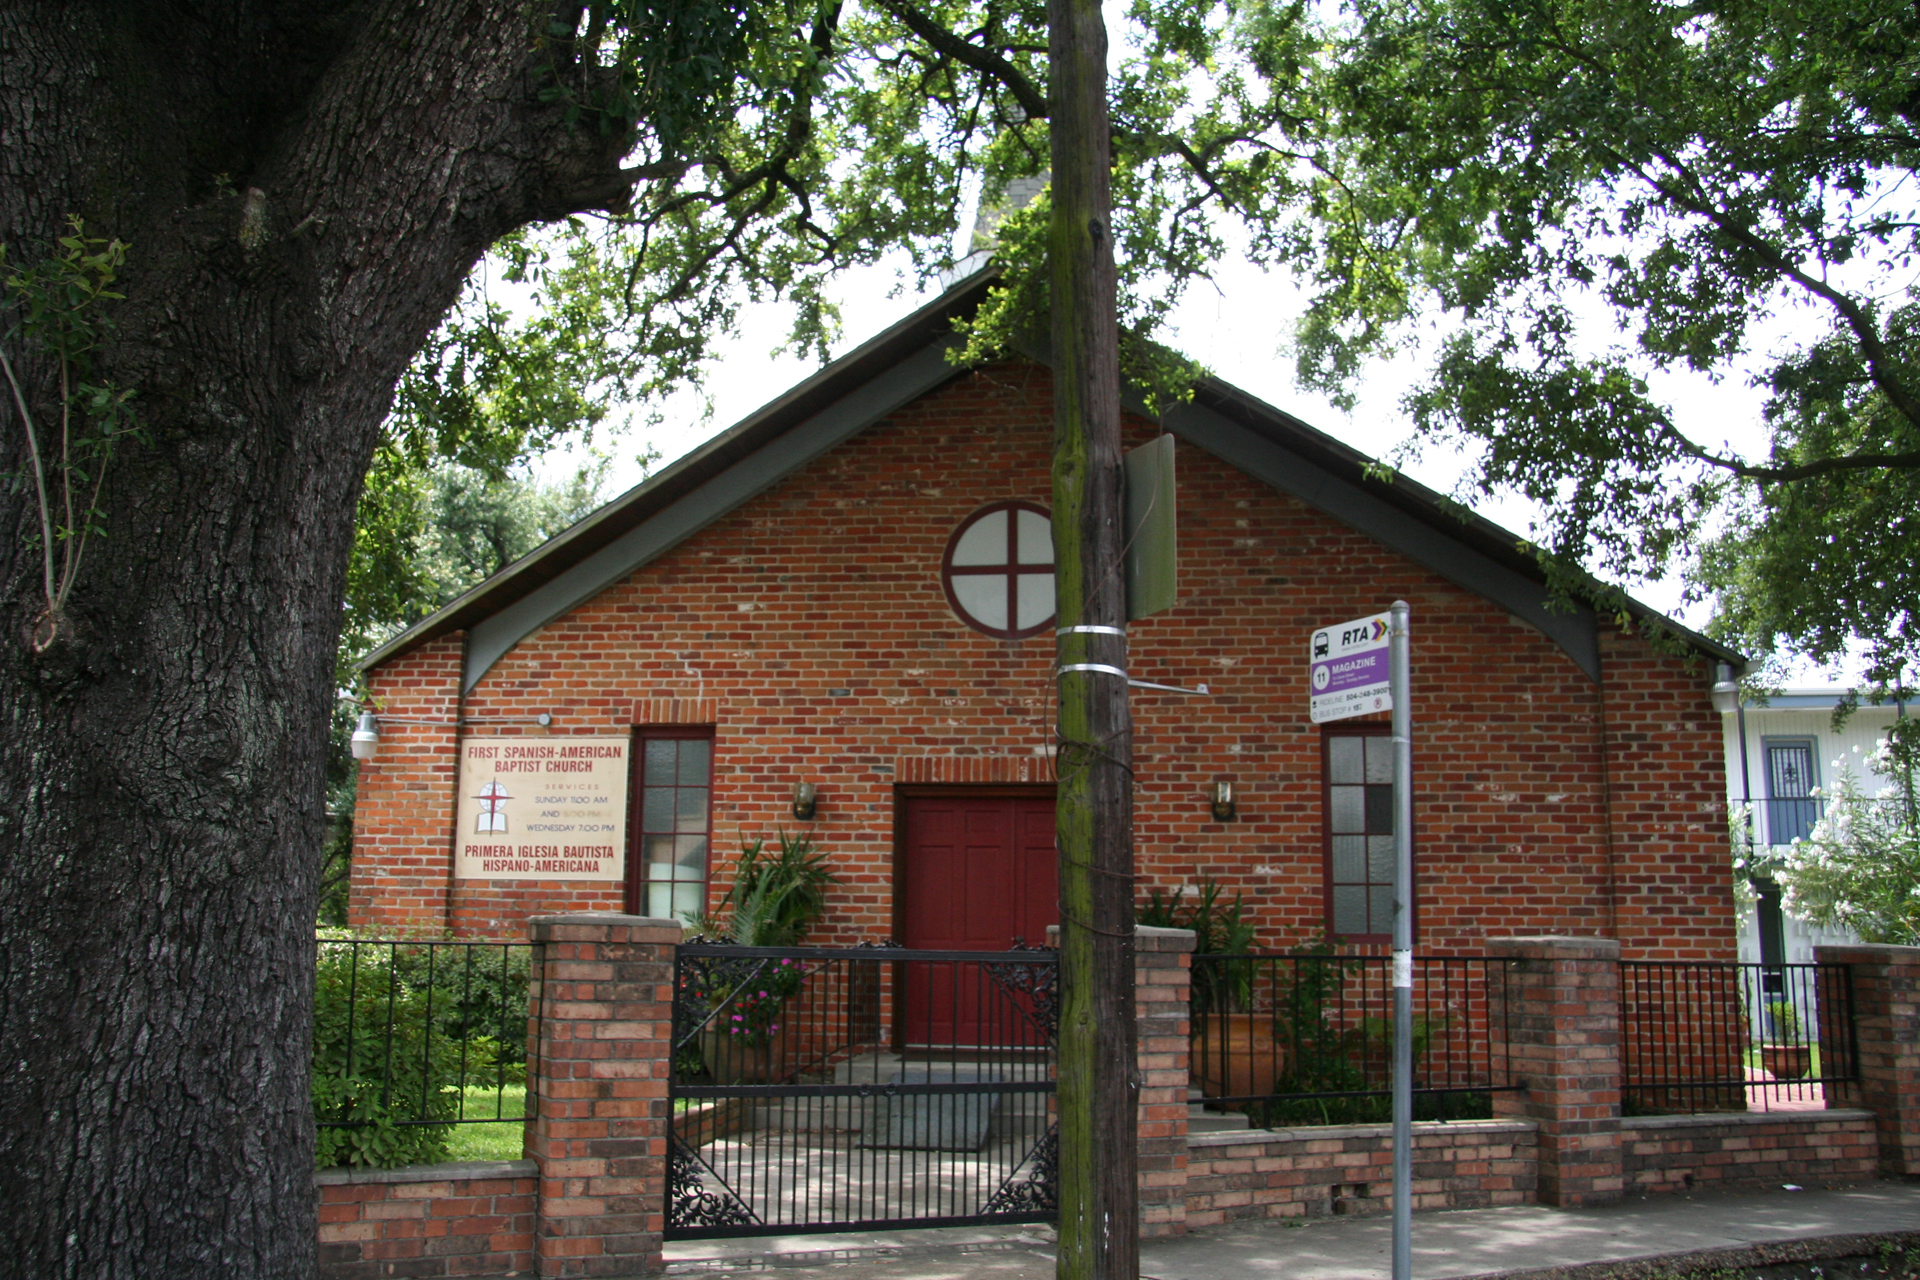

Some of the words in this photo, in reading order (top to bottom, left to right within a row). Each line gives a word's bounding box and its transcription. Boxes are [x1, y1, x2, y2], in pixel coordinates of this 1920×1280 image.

[1342, 626, 1369, 646] RTA
[1332, 656, 1376, 675] MAGAZINE
[1317, 672, 1326, 683] 11
[468, 746, 500, 759] FIRST
[504, 746, 622, 759] SPANISH-AMERICAN
[495, 760, 541, 773] BAPTIST
[546, 760, 593, 773] CHURCH
[534, 796, 567, 804] SUNDAY
[593, 796, 608, 804] AM
[540, 810, 560, 818] AND
[526, 824, 575, 832] WEDNESDAY
[601, 824, 615, 832] PM
[465, 845, 513, 858] PRIMERA
[518, 845, 558, 858] IGLESIA
[563, 845, 614, 859] BAUTISTA
[483, 859, 600, 873] HISPANO-AMERICANA
